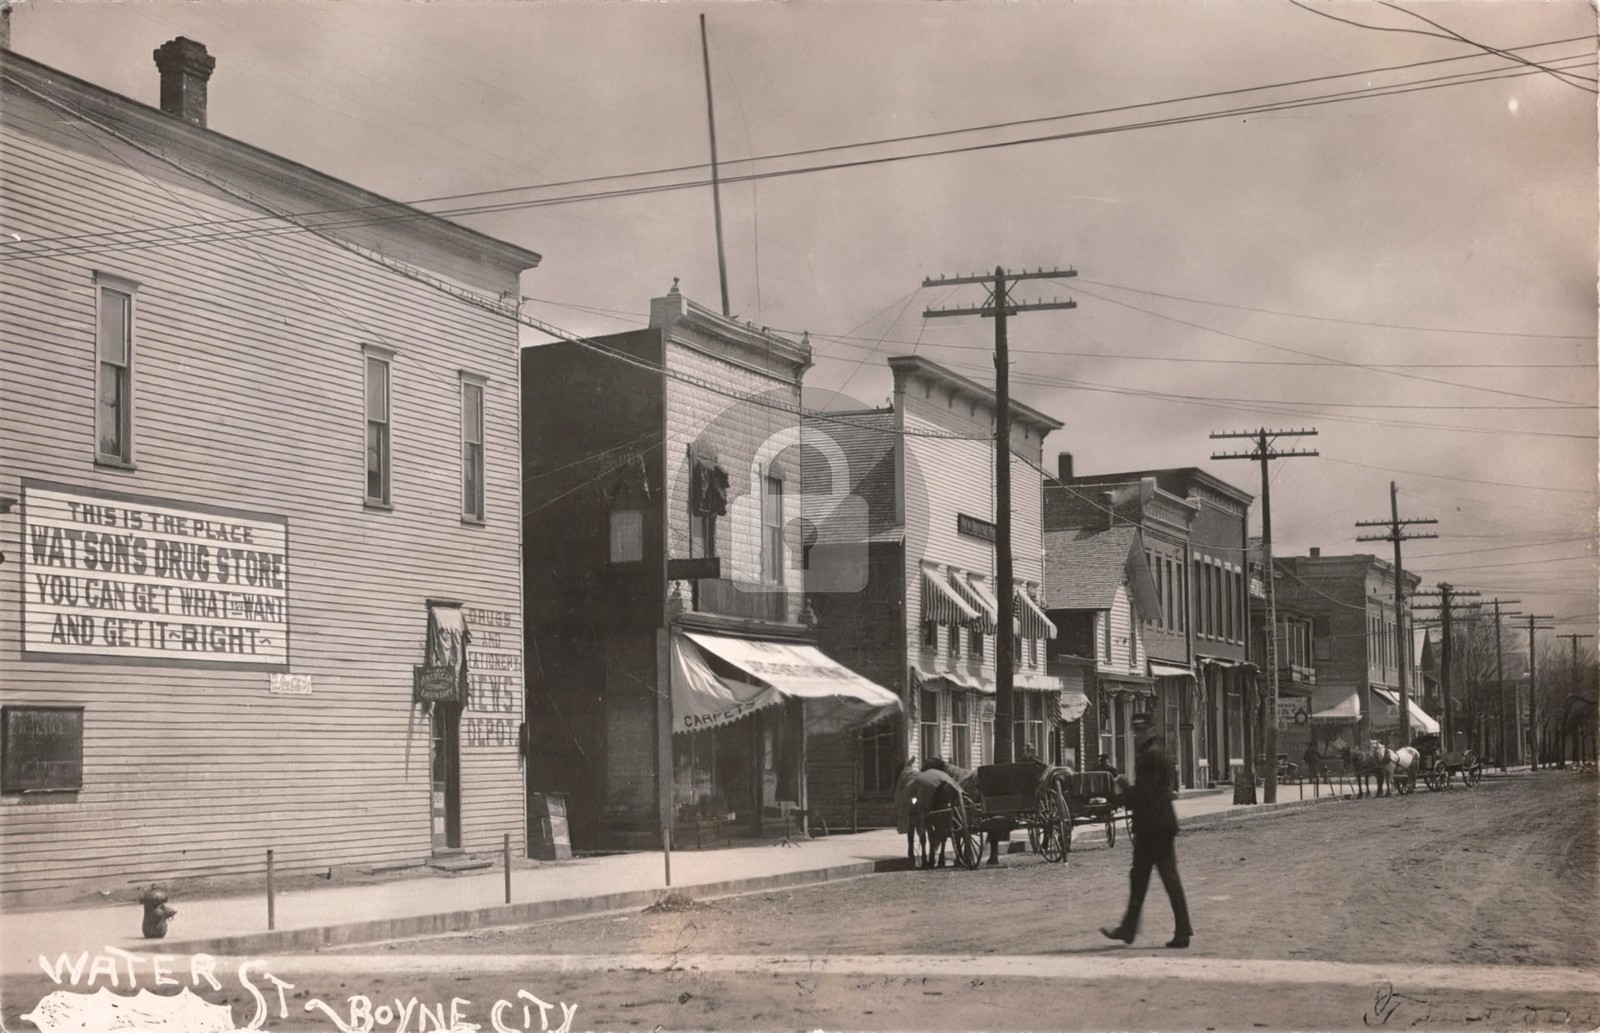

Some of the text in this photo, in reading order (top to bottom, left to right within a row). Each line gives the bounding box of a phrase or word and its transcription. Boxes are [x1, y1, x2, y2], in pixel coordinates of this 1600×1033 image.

[68, 502, 254, 544] THIS IS THE PLACE
[30, 524, 283, 590] WATSON'S DRUG STORE
[35, 573, 79, 606] YOU
[85, 579, 125, 610] CAN
[133, 583, 172, 614] GET
[180, 587, 230, 619] WHAT
[242, 593, 284, 623] WANT
[469, 609, 511, 627] DRUGS
[51, 613, 261, 654] AND GET IT RIGHT
[468, 719, 514, 746] DEPOT
